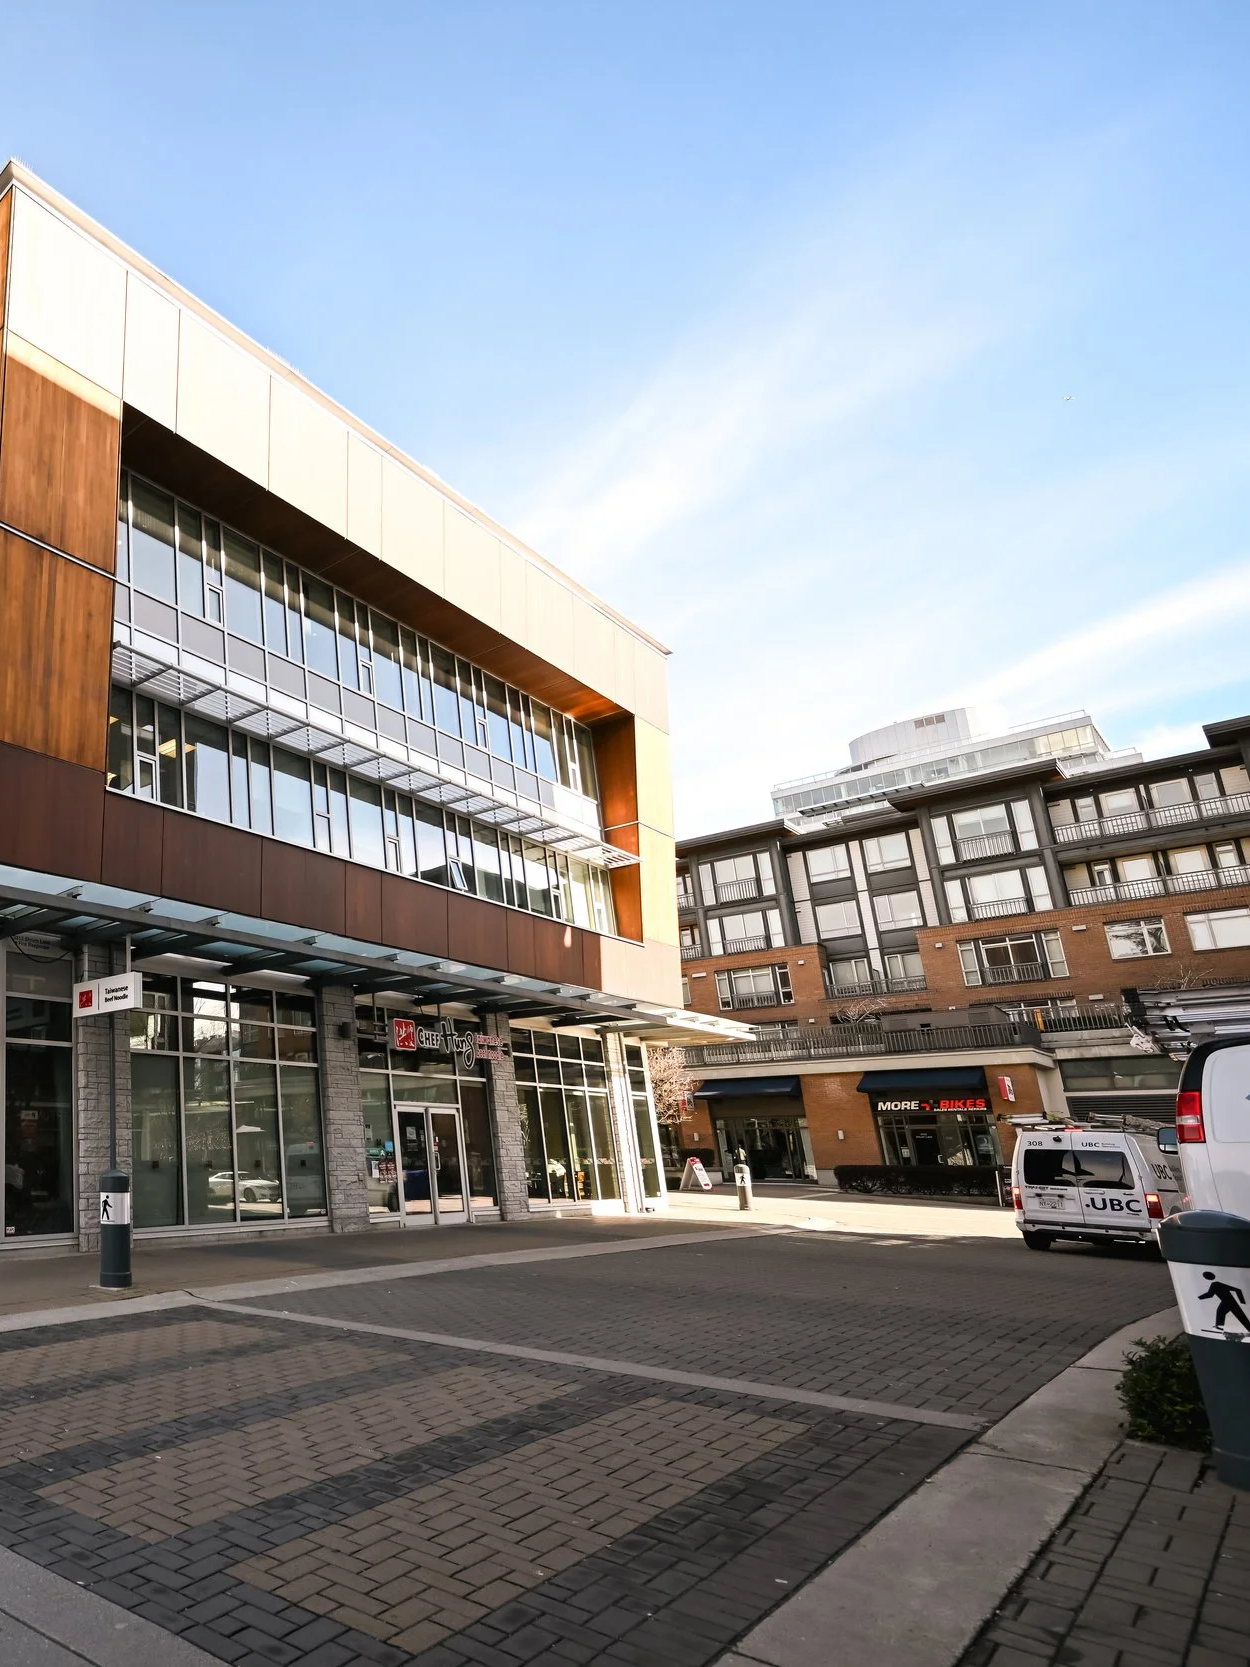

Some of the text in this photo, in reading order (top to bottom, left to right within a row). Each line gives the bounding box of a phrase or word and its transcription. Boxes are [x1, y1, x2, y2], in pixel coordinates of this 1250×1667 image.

[104, 985, 129, 995] Taiwanese
[114, 994, 129, 1002] Noodle
[417, 1016, 475, 1070] CHEF Hung
[877, 1098, 986, 1111] MORE BIKES
[1151, 1163, 1172, 1180] UBC
[1090, 1197, 1143, 1213] UBC
